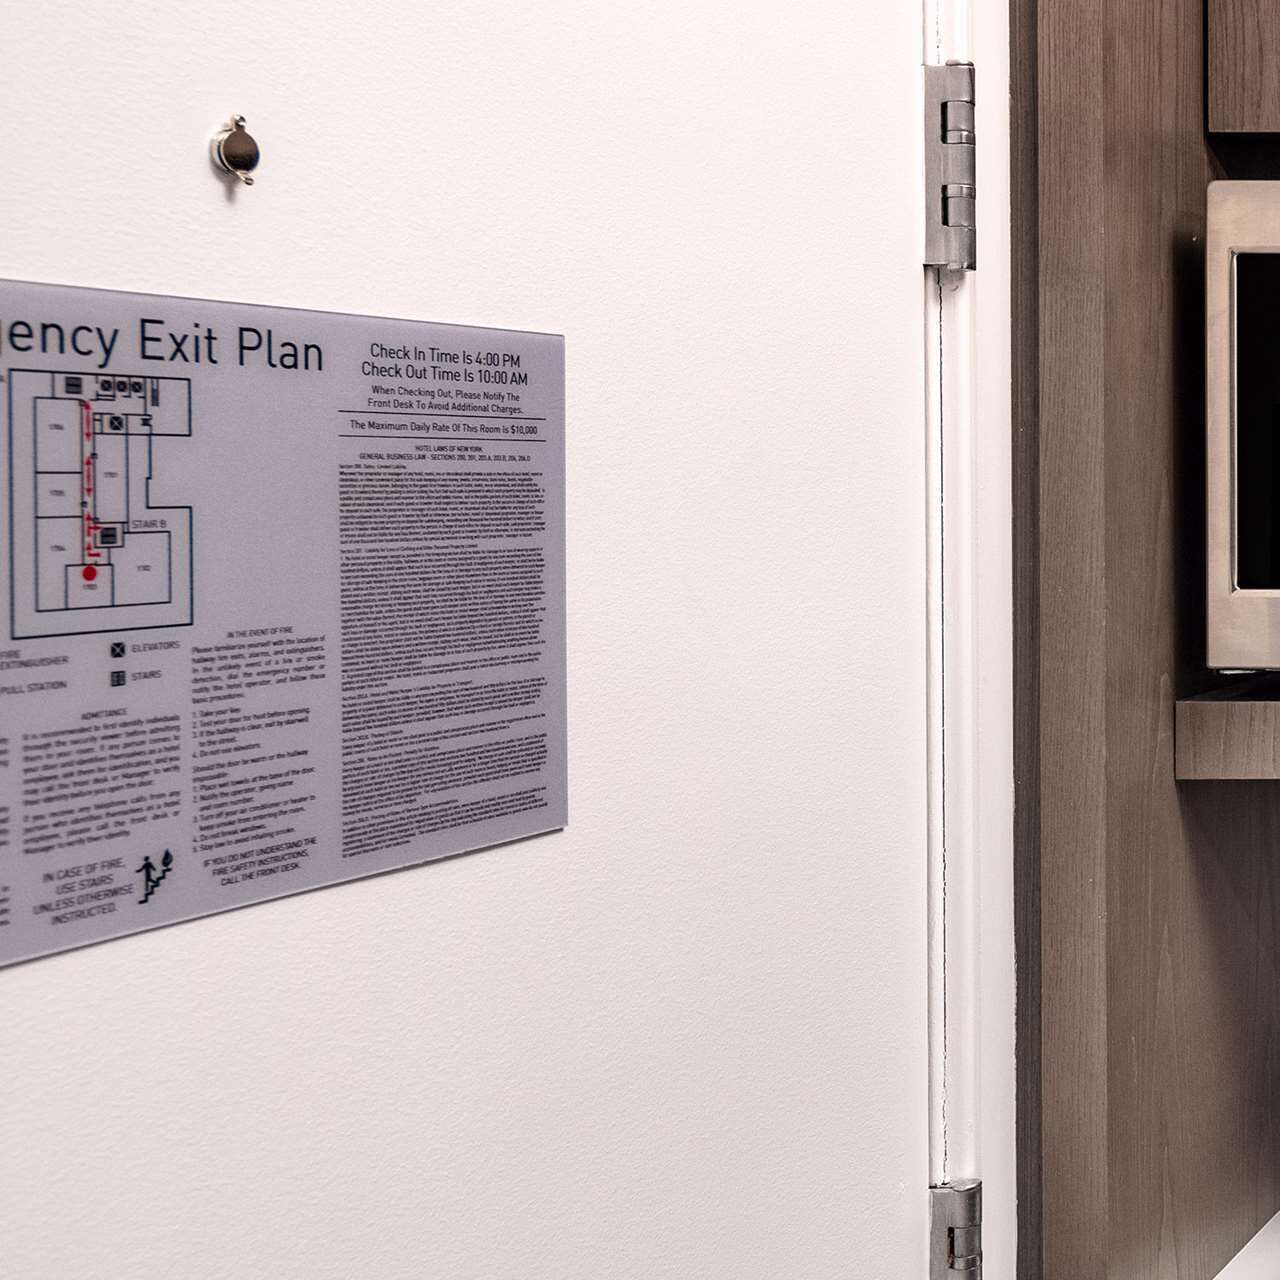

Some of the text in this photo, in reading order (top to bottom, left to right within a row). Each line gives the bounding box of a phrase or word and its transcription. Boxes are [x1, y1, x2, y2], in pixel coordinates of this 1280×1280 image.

[0, 319, 322, 370] ency Exit Plan
[370, 343, 521, 368] Check In Time Is 4:00 PM
[361, 361, 528, 385] Check Out Time Is 10:00 AM
[371, 385, 395, 395] When
[398, 386, 435, 399] Checking
[456, 389, 481, 400] Please
[483, 392, 505, 402] Notify
[506, 392, 520, 401] The
[368, 398, 391, 407] Front
[393, 399, 414, 408] Desk
[416, 400, 426, 409] To
[427, 401, 450, 410] Avoid
[451, 402, 490, 412] Additional
[350, 420, 366, 429] The
[368, 421, 408, 430] Maximum
[410, 422, 430, 433] Daily
[432, 423, 450, 432] Rate
[452, 424, 460, 432] Of
[462, 424, 478, 432] This
[480, 424, 500, 433] Room
[132, 520, 167, 529] STAIR B
[249, 628, 269, 636] EVENT
[132, 640, 181, 653] ELEVATORS
[132, 670, 162, 681] STAIRS
[1, 681, 67, 694] PULL STATION
[203, 836, 318, 867] IF YOU DO NOT UNDERSTAND THE
[42, 873, 54, 883] IN
[56, 866, 82, 880] CASE
[85, 862, 98, 874] OF
[212, 866, 229, 876] FIRE
[230, 860, 257, 873] SAFETY
[221, 876, 240, 886] CALL
[241, 872, 256, 881] THE
[256, 866, 280, 876] FRONT
[55, 873, 114, 895] USE STAIRS
[32, 897, 75, 915] UNLESS
[76, 883, 134, 905] OTHERWISE
